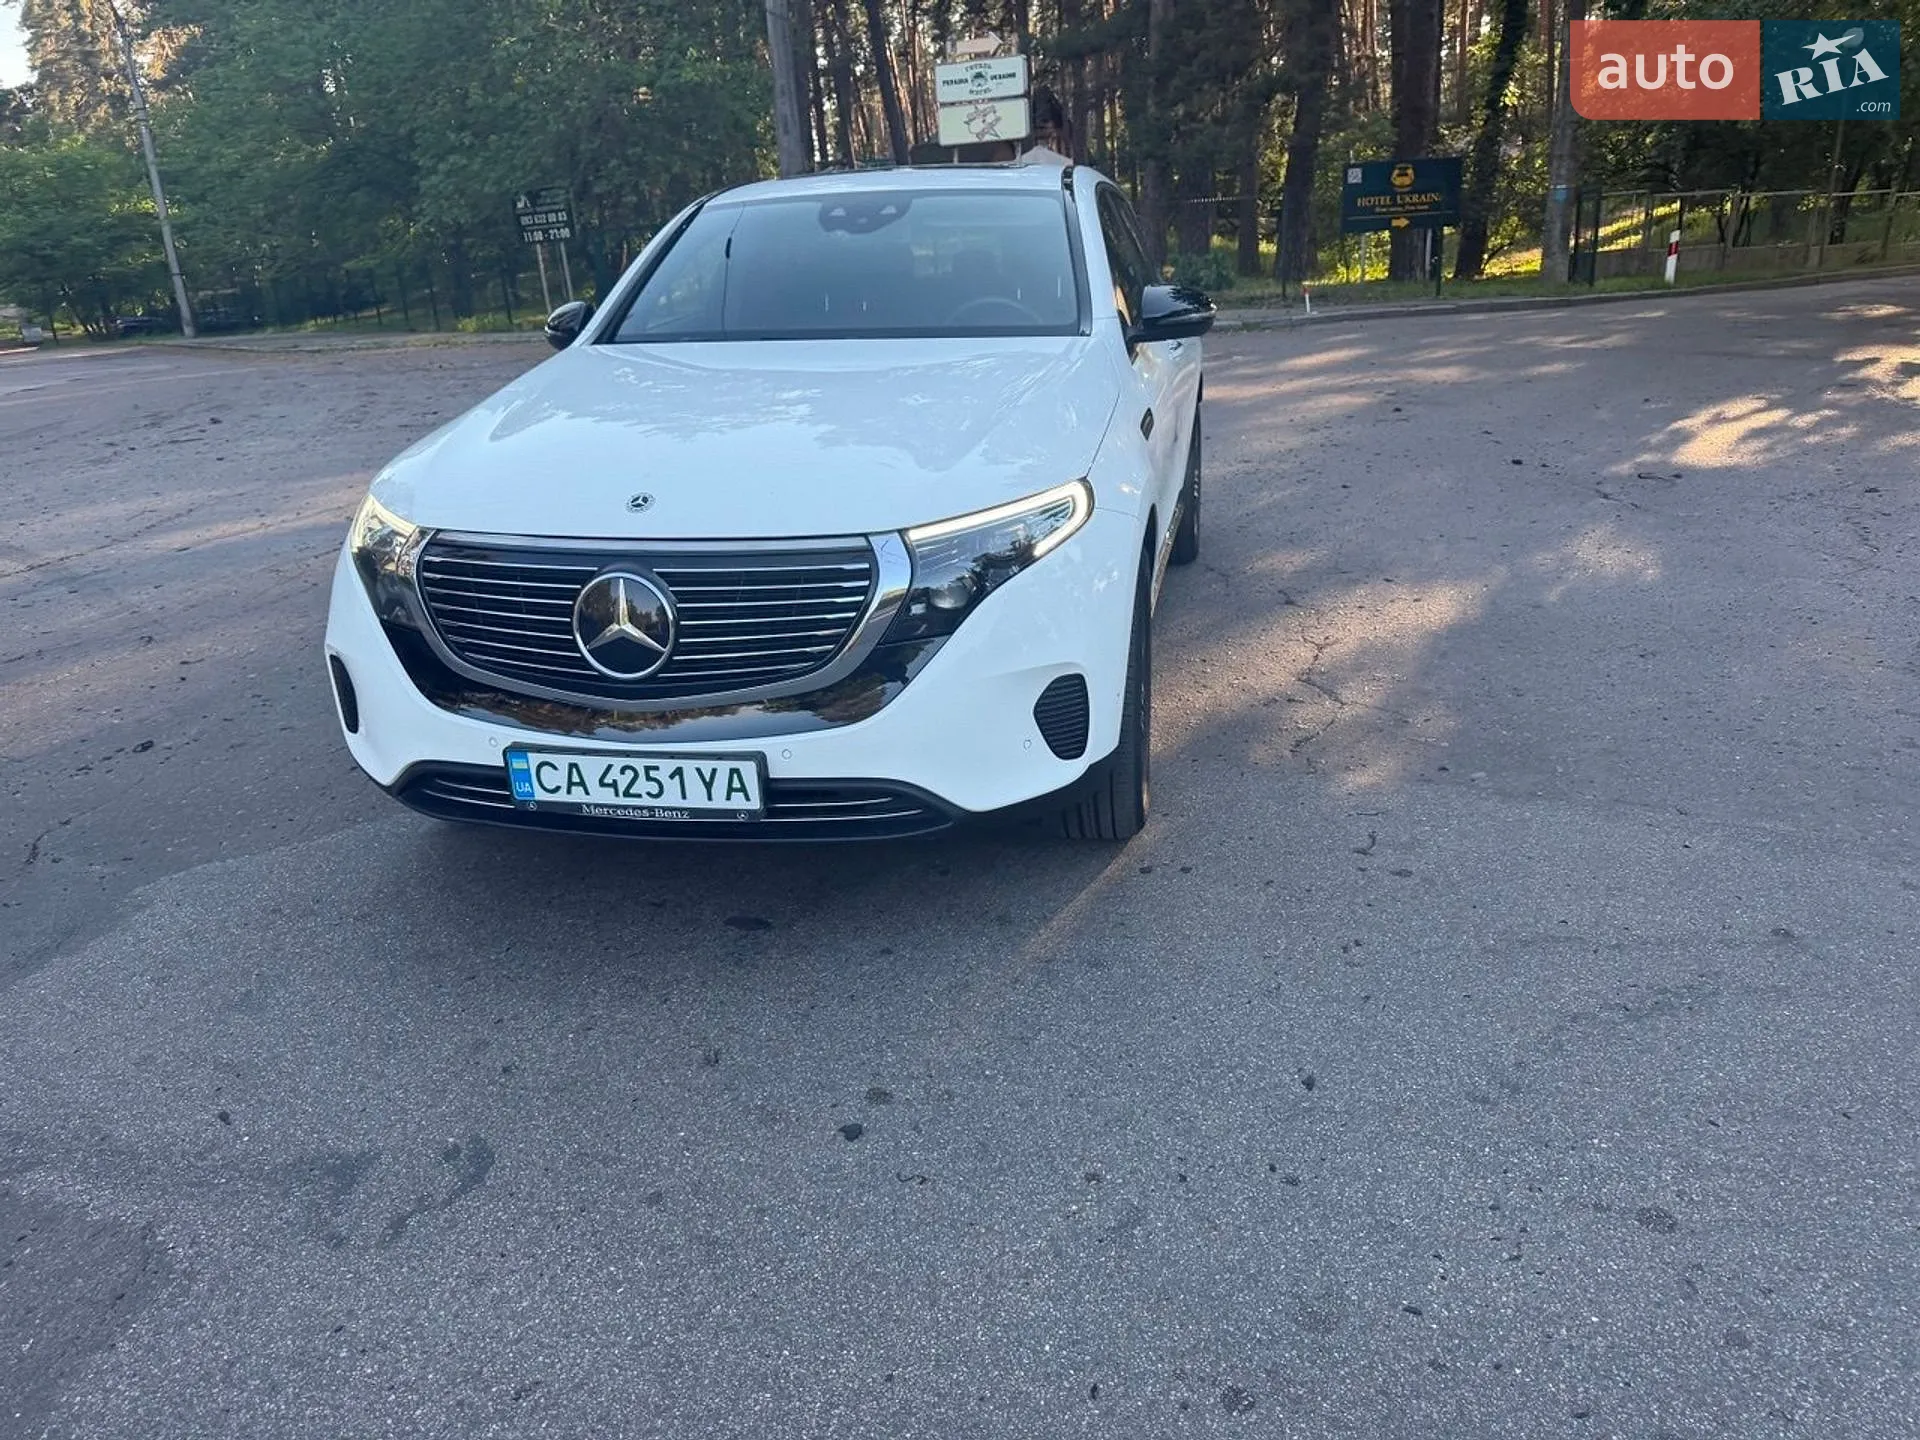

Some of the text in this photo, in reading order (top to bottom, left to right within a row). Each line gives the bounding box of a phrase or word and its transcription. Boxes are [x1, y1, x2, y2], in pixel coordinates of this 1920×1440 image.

[1357, 195, 1393, 207] HOTEL
[516, 781, 533, 794] UA
[535, 760, 752, 802] CA 4251 YA
[581, 804, 690, 819] Mercedes-Benz
